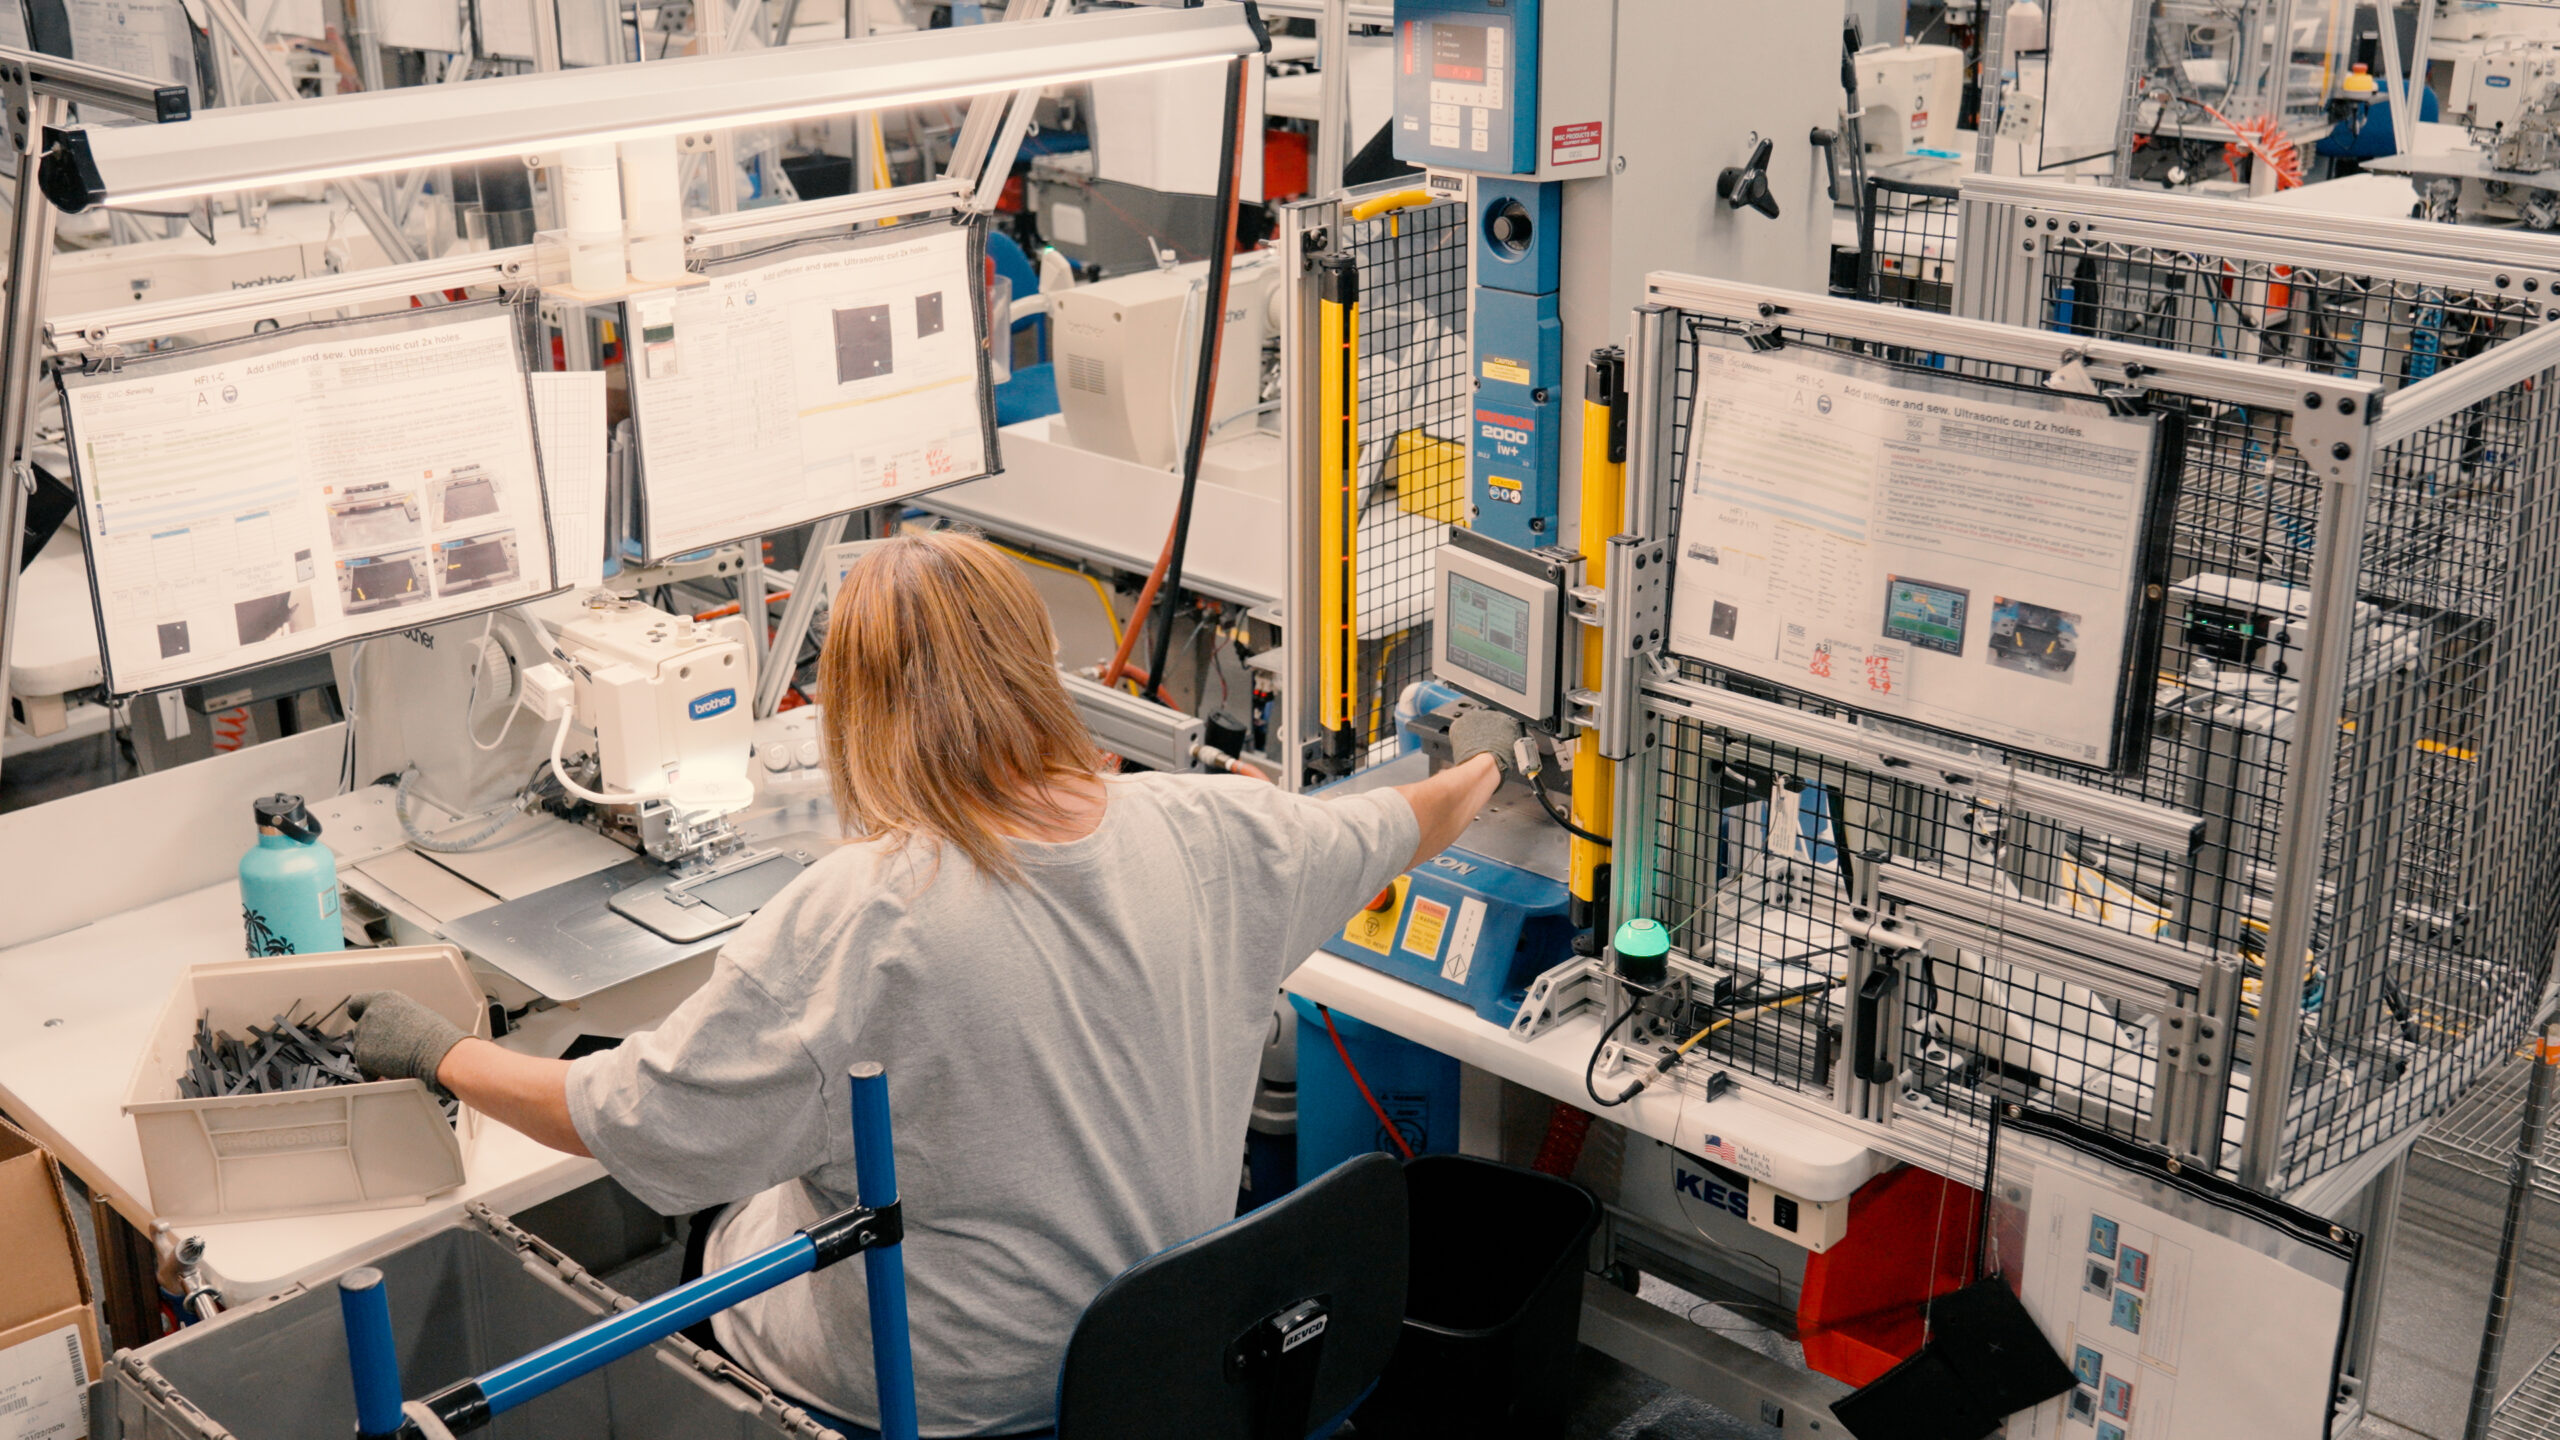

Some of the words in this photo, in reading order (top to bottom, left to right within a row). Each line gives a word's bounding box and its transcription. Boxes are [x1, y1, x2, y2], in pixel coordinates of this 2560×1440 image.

[844, 253, 885, 266] Ultrasonic
[302, 352, 320, 363] and
[349, 342, 401, 357] Ultrasonic
[403, 339, 420, 350] cut
[434, 332, 463, 345] holes.
[197, 392, 209, 406] A
[1793, 390, 1805, 406] A
[1476, 409, 1535, 431] BRANSON
[1843, 385, 1861, 398] Add
[1863, 389, 1901, 408] stiffener
[1902, 400, 1924, 412] and
[1926, 404, 1951, 417] sew.
[1954, 407, 2010, 426] Ultrasonic
[2012, 418, 2032, 430] cut
[2034, 420, 2048, 432] 2x
[2050, 423, 2085, 438] holes.
[1481, 424, 1528, 445] 2000
[1497, 442, 1519, 457] iw+
[694, 695, 733, 714] brother
[1742, 1146, 1760, 1158] Made
